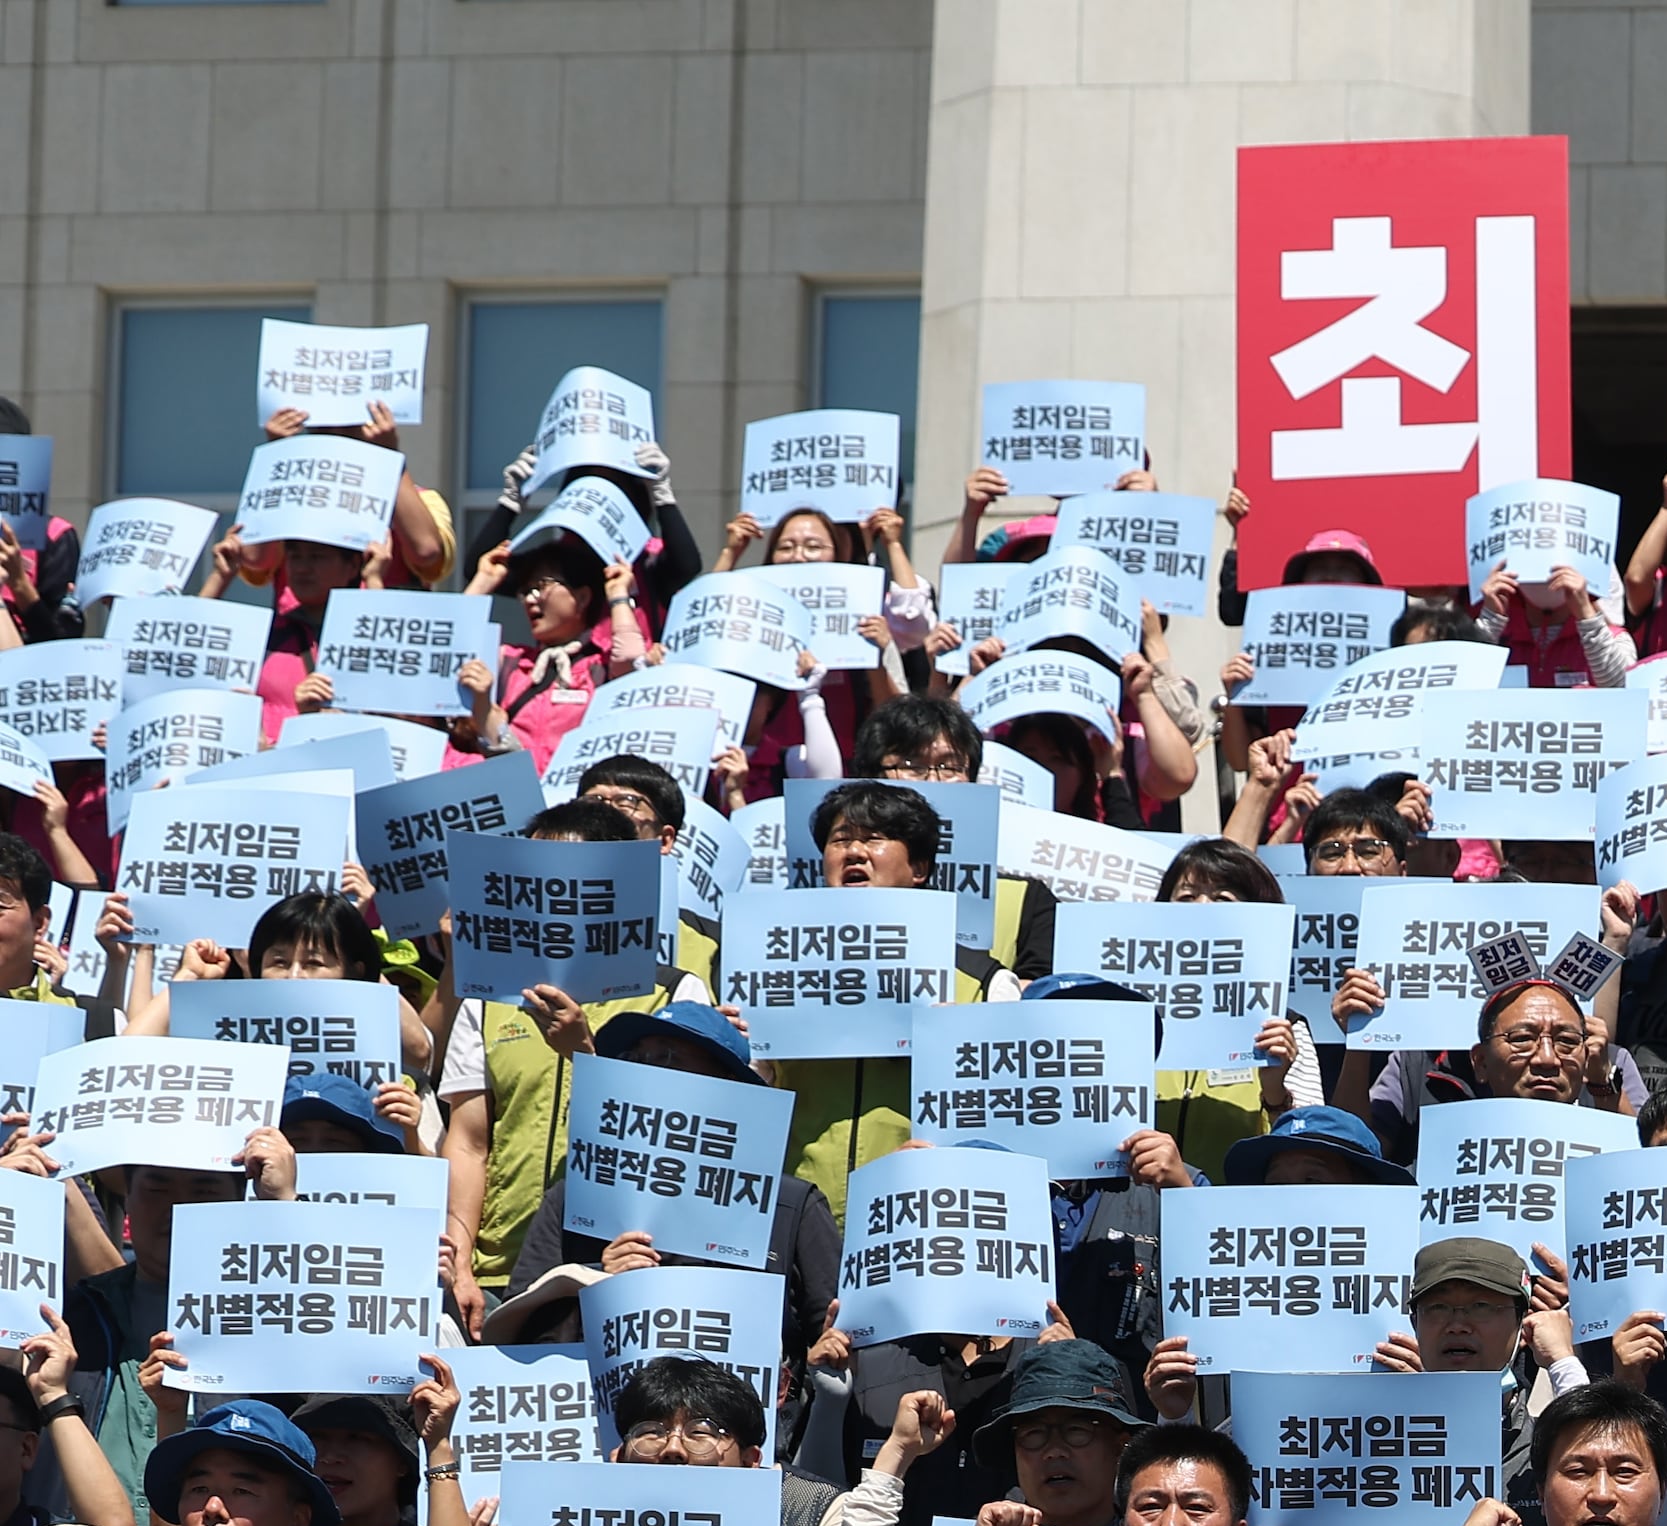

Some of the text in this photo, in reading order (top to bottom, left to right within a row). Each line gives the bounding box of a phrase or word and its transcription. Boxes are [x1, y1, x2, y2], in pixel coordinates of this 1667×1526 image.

[295, 347, 393, 371] 최저임금
[1270, 215, 1536, 492] 최
[263, 368, 418, 396] 차별적용 폐지
[1013, 405, 1111, 430] 최저임금
[771, 435, 865, 462] 최저임금
[986, 435, 1139, 461] 차별적용 폐지
[269, 458, 364, 487] 최저임금
[746, 464, 893, 494] 차별적용 폐지
[242, 485, 388, 522] 차별적용 폐지
[484, 871, 615, 915] 최저임금
[455, 910, 654, 960] 차별적용 폐지
[766, 925, 908, 962] 최저임금
[1476, 937, 1522, 968] 최저
[1485, 956, 1531, 987] 임금
[1553, 959, 1598, 992] 반대
[1567, 940, 1614, 974] 차별
[727, 968, 948, 1007] 차별적용 폐지
[955, 1039, 1105, 1080] 최저임금
[917, 1085, 1148, 1129] 차별적용 폐지
[599, 1098, 737, 1160] 최저임금
[570, 1137, 773, 1214] 차별적용 폐지
[868, 1188, 1008, 1236] 최저임금
[221, 1243, 384, 1286] 최저임금
[842, 1236, 1049, 1290] 차별적용 폐지
[175, 1293, 429, 1337] 차별적용 폐지
